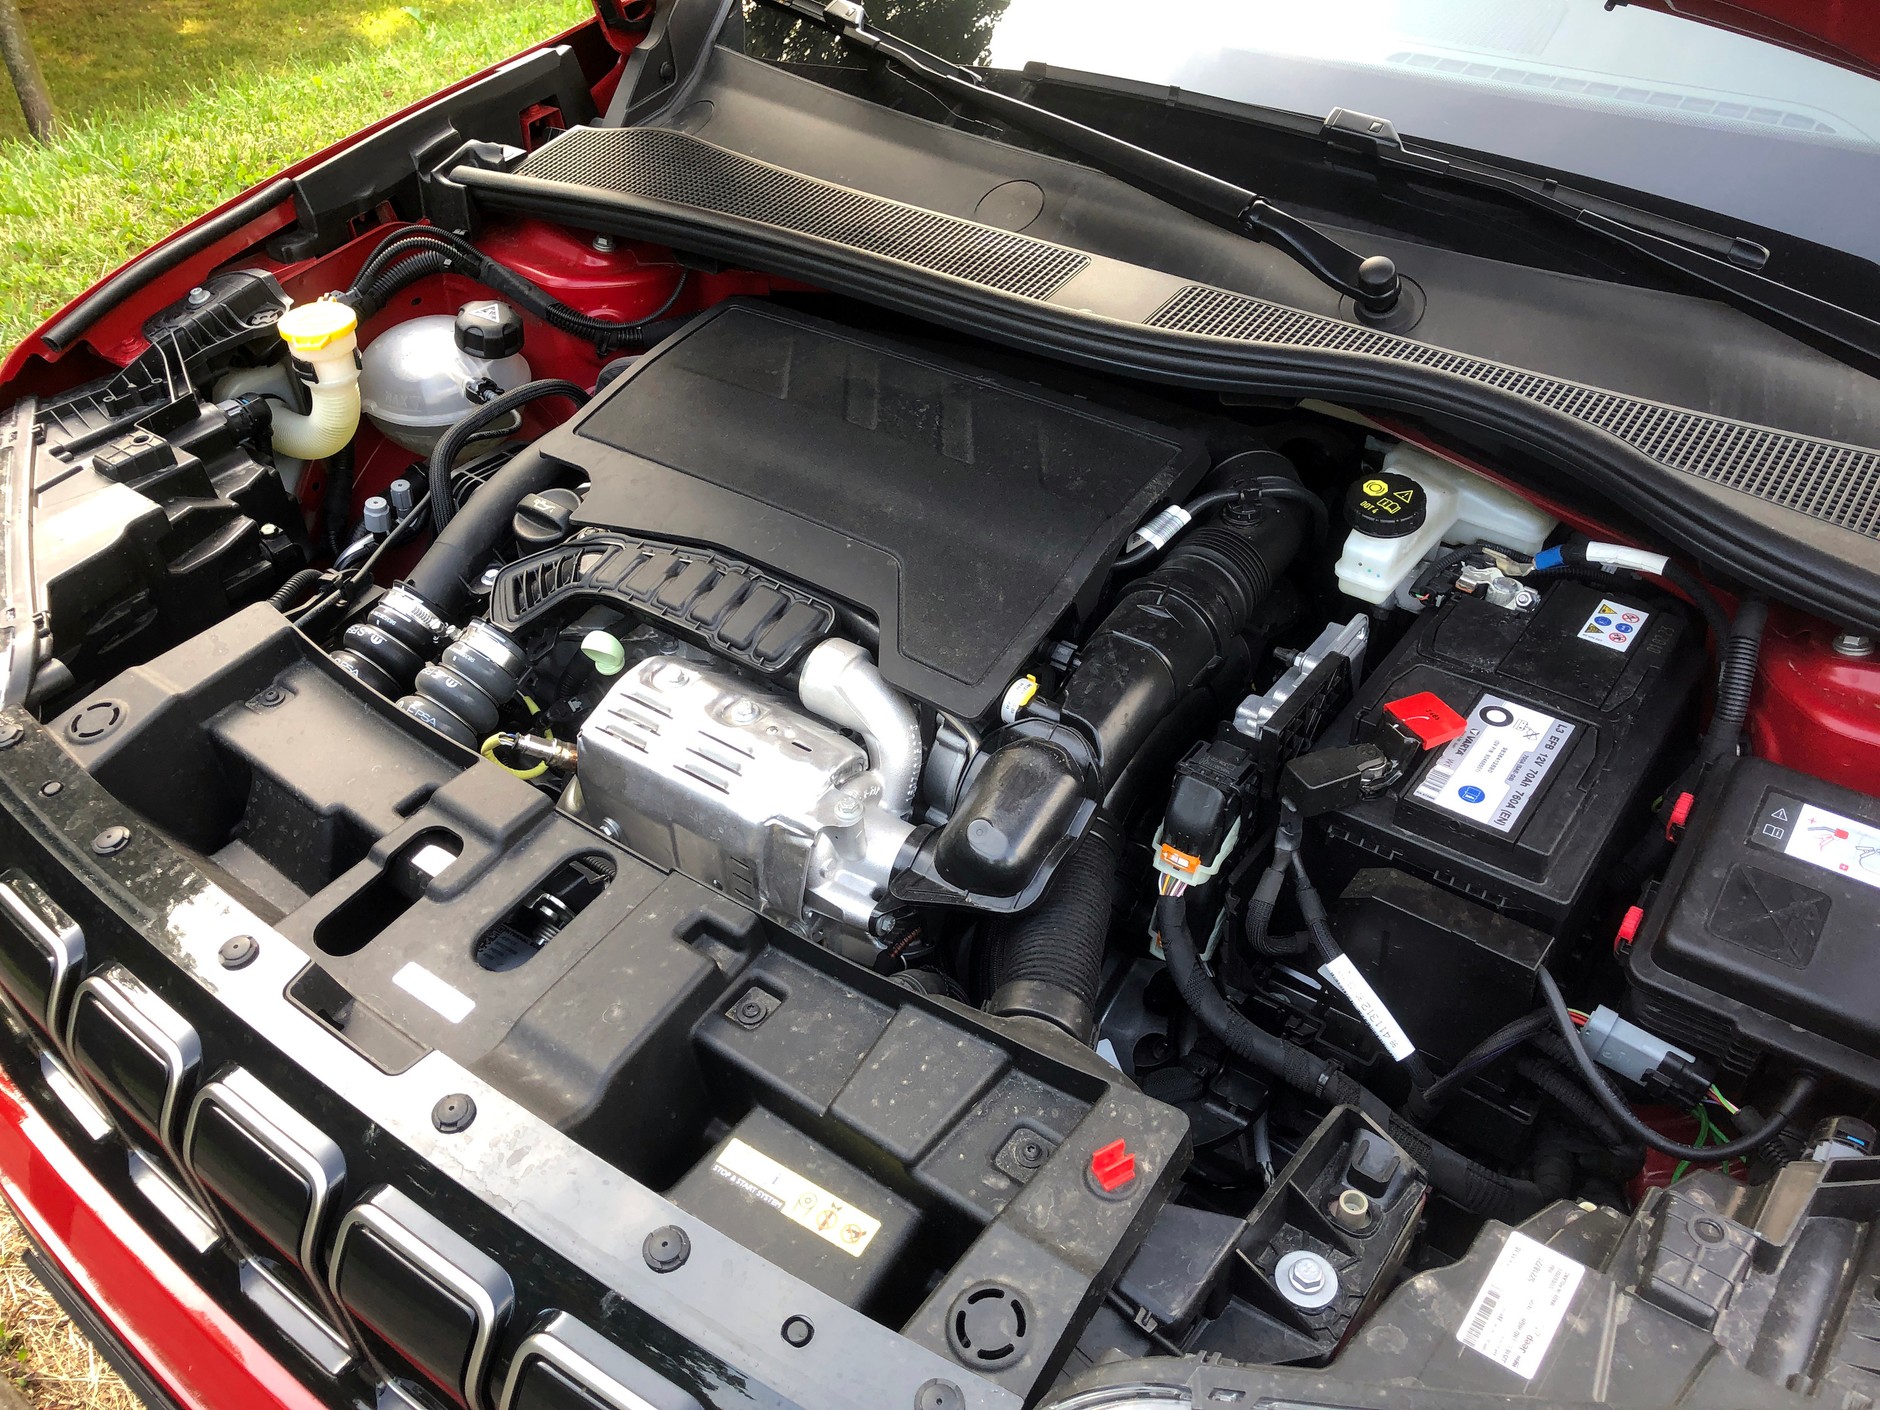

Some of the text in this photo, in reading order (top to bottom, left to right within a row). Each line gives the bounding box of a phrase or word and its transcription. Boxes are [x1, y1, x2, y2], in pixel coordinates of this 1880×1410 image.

[1360, 501, 1375, 510] DOT
[1455, 736, 1476, 756] VARTA
[1494, 724, 1567, 826] L3 EFB 12V 70Ah 760A (EN)
[713, 1164, 731, 1178] STOP
[736, 1178, 759, 1194] START
[756, 1190, 783, 1209] SYSTEM
[1520, 1335, 1533, 1353] Jeep
